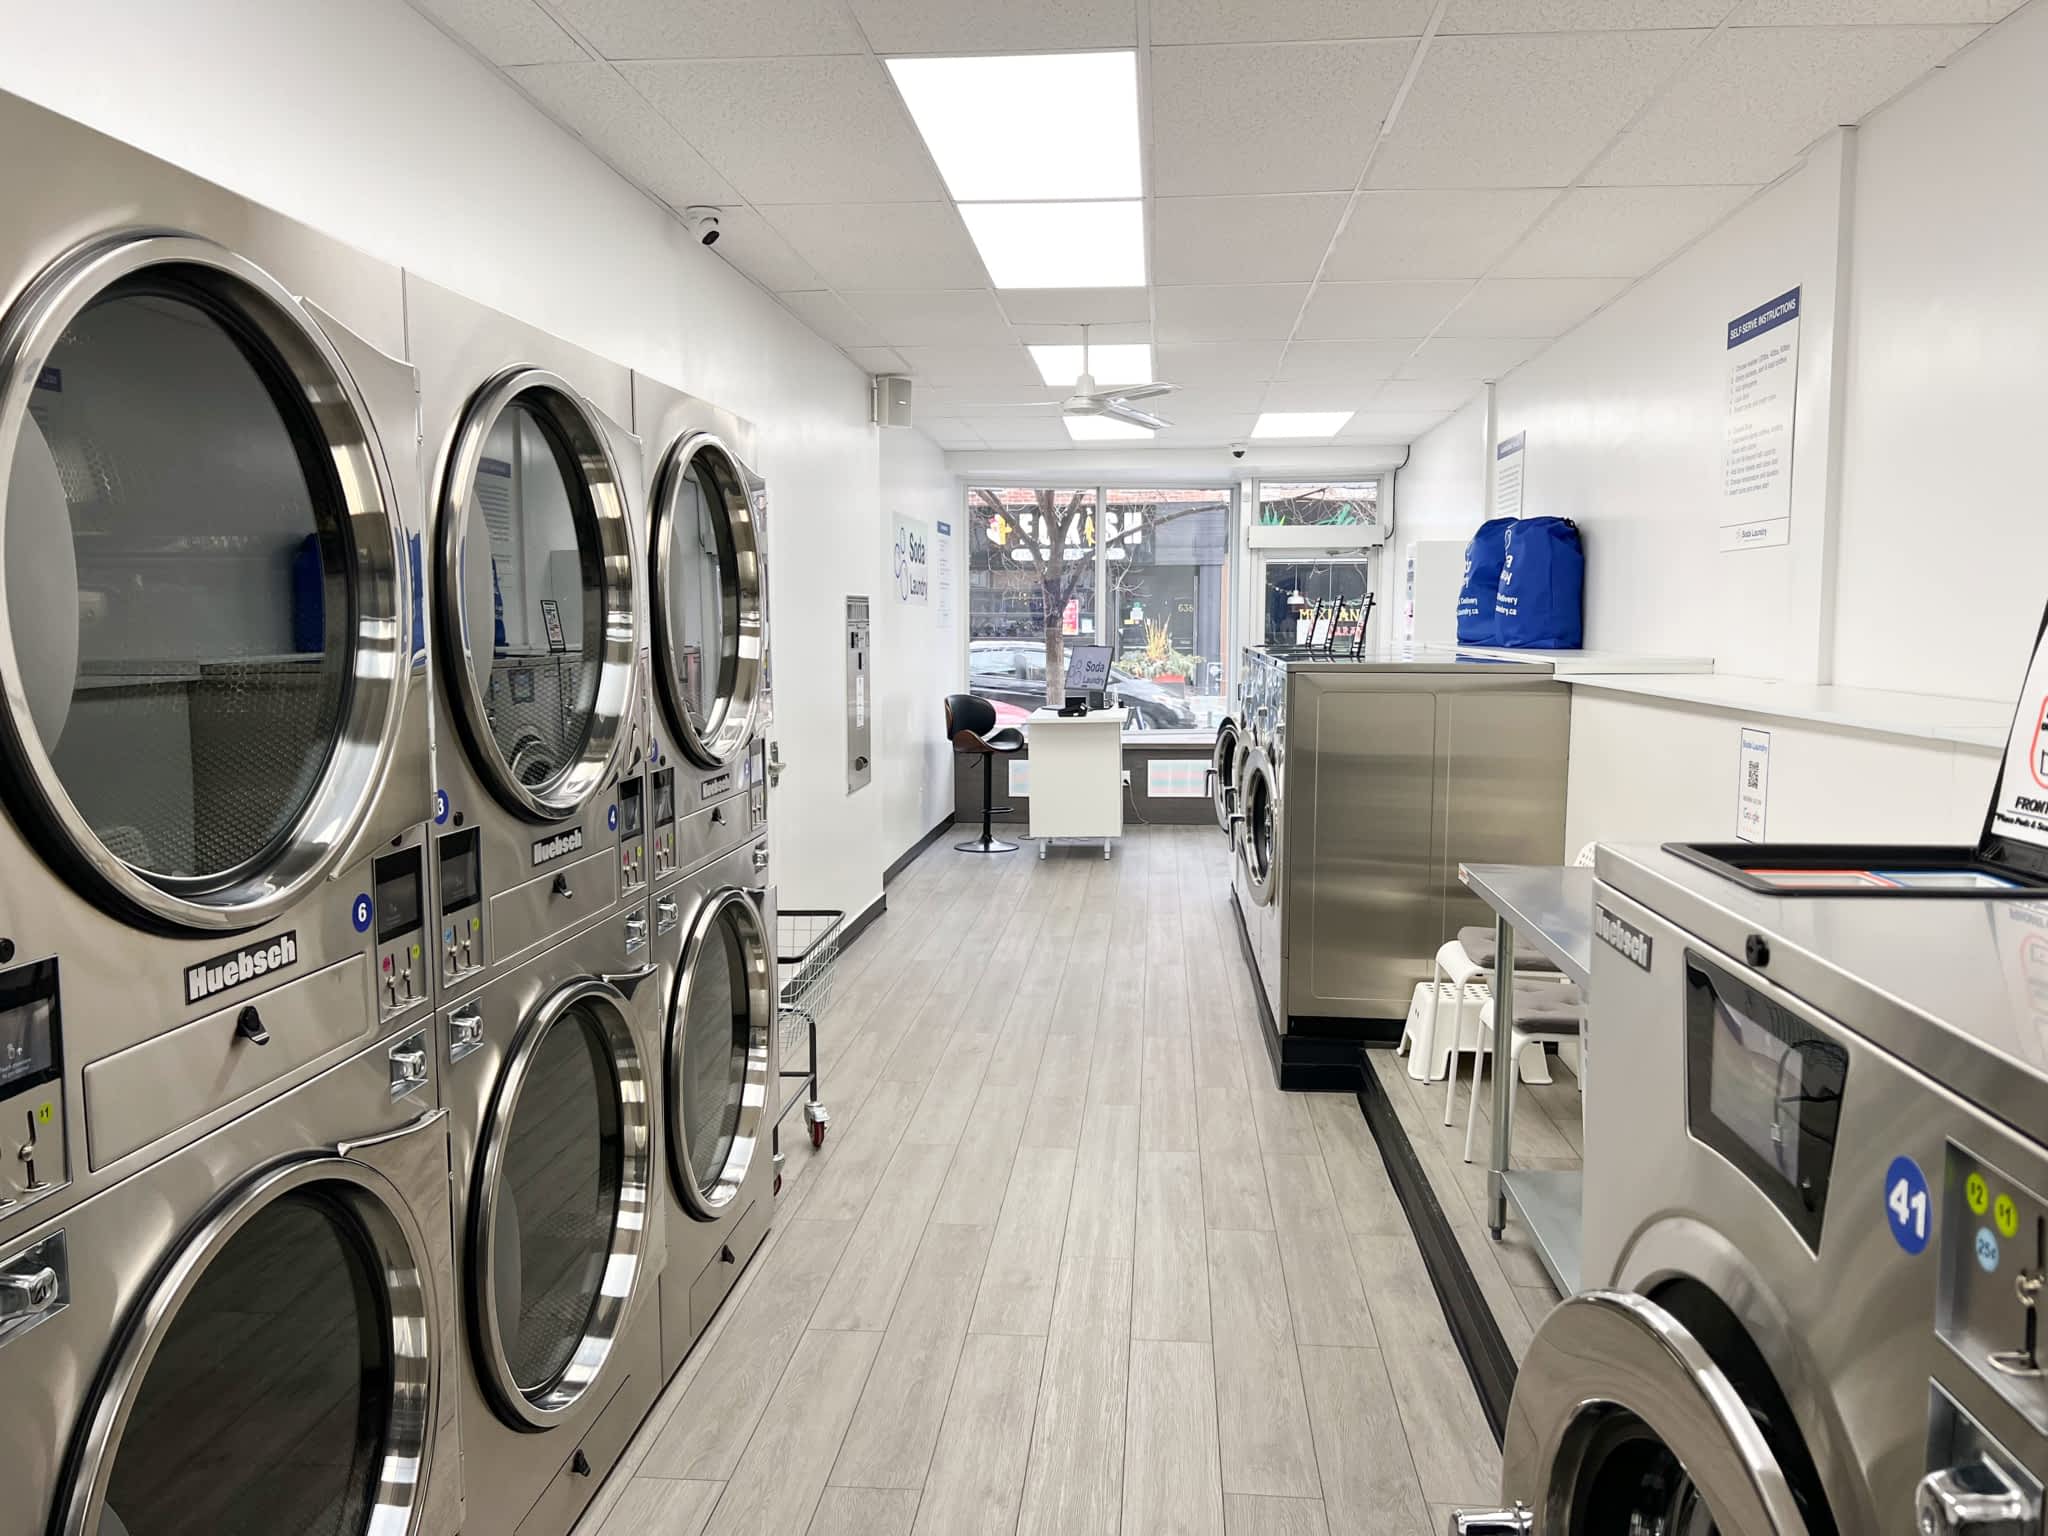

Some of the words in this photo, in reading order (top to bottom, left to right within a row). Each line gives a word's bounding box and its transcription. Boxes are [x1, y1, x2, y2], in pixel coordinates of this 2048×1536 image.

[1730, 318, 1758, 340] SELF-SERVE
[1758, 298, 1796, 326] INSTRUCTIONS
[909, 532, 926, 565] Soda
[909, 573, 928, 600] Laundry
[1299, 608, 1361, 622] MXIAN
[1085, 660, 1105, 673] Soda
[437, 796, 445, 816] 3
[533, 829, 583, 865] Huebsch
[358, 902, 367, 923] 6
[188, 935, 296, 1001] Huebsch
[1889, 1178, 1927, 1239] 41
